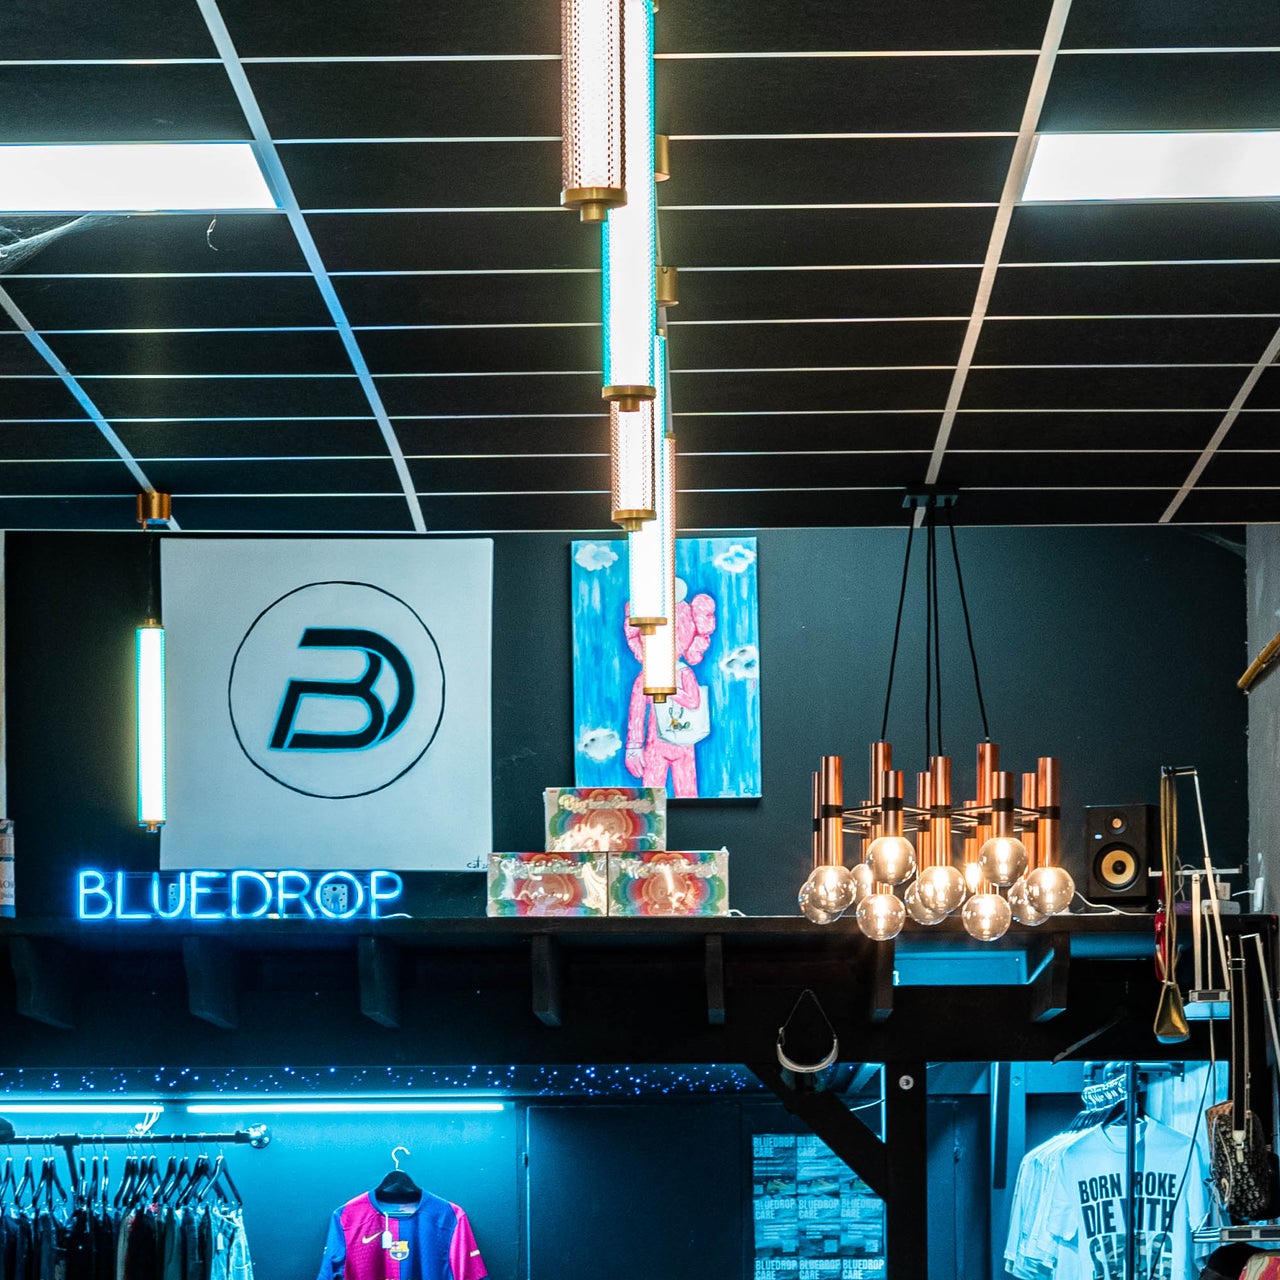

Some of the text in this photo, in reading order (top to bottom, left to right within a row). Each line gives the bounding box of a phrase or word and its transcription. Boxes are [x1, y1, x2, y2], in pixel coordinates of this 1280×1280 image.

[78, 869, 404, 920] BLUEDROP
[1078, 1173, 1122, 1204] BORN
[1134, 1171, 1176, 1197] ROKE
[1081, 1199, 1116, 1239] DIE
